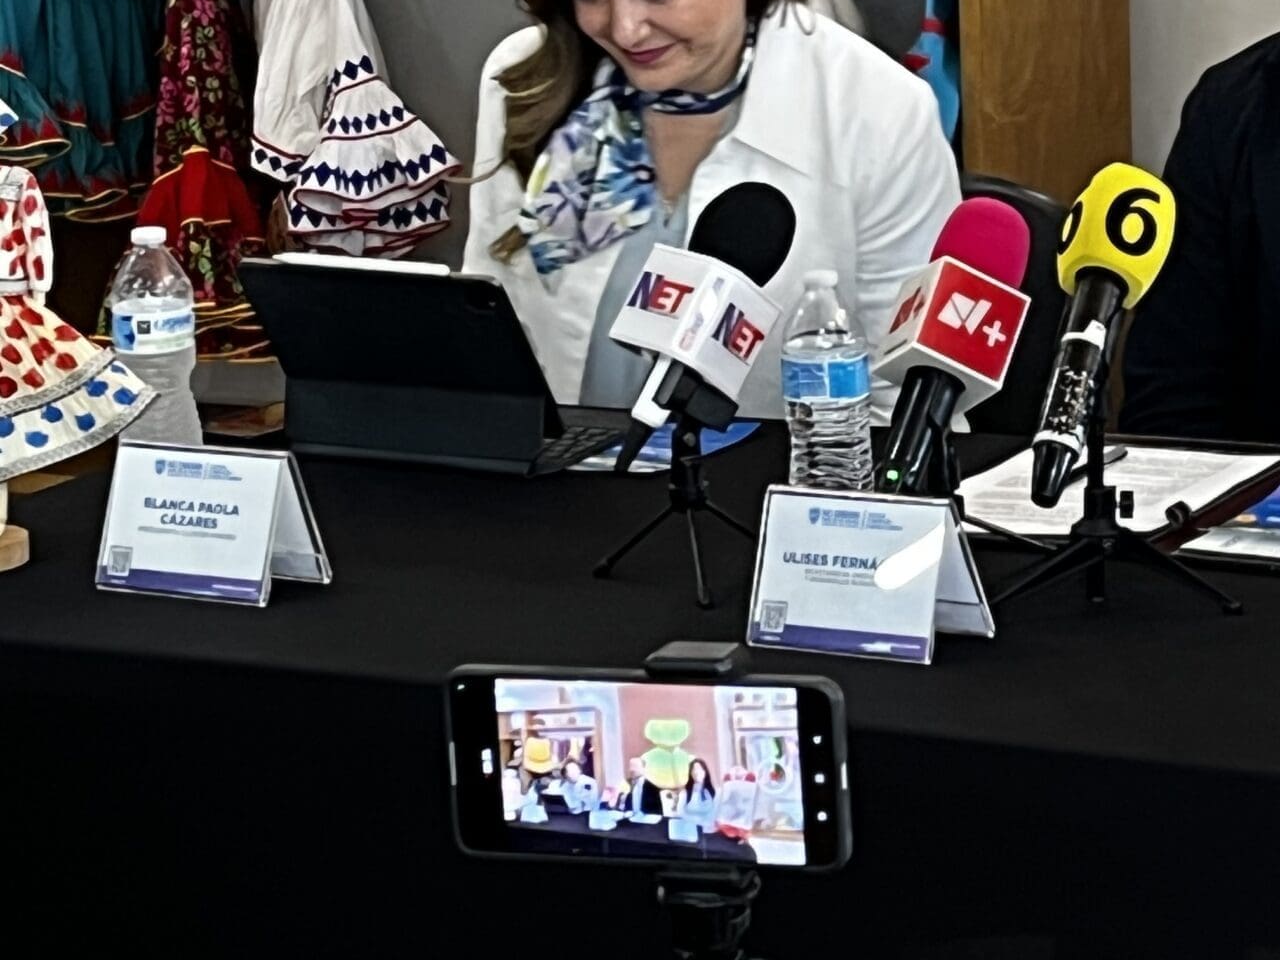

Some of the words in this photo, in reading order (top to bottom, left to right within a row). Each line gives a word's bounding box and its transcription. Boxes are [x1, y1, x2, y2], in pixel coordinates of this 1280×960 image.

[627, 271, 695, 315] NET
[712, 302, 765, 360] NET
[144, 497, 195, 513] BLANCA
[198, 502, 240, 516] PAOLA
[783, 551, 828, 566] ULISES
[832, 553, 884, 571] FERNÁ
